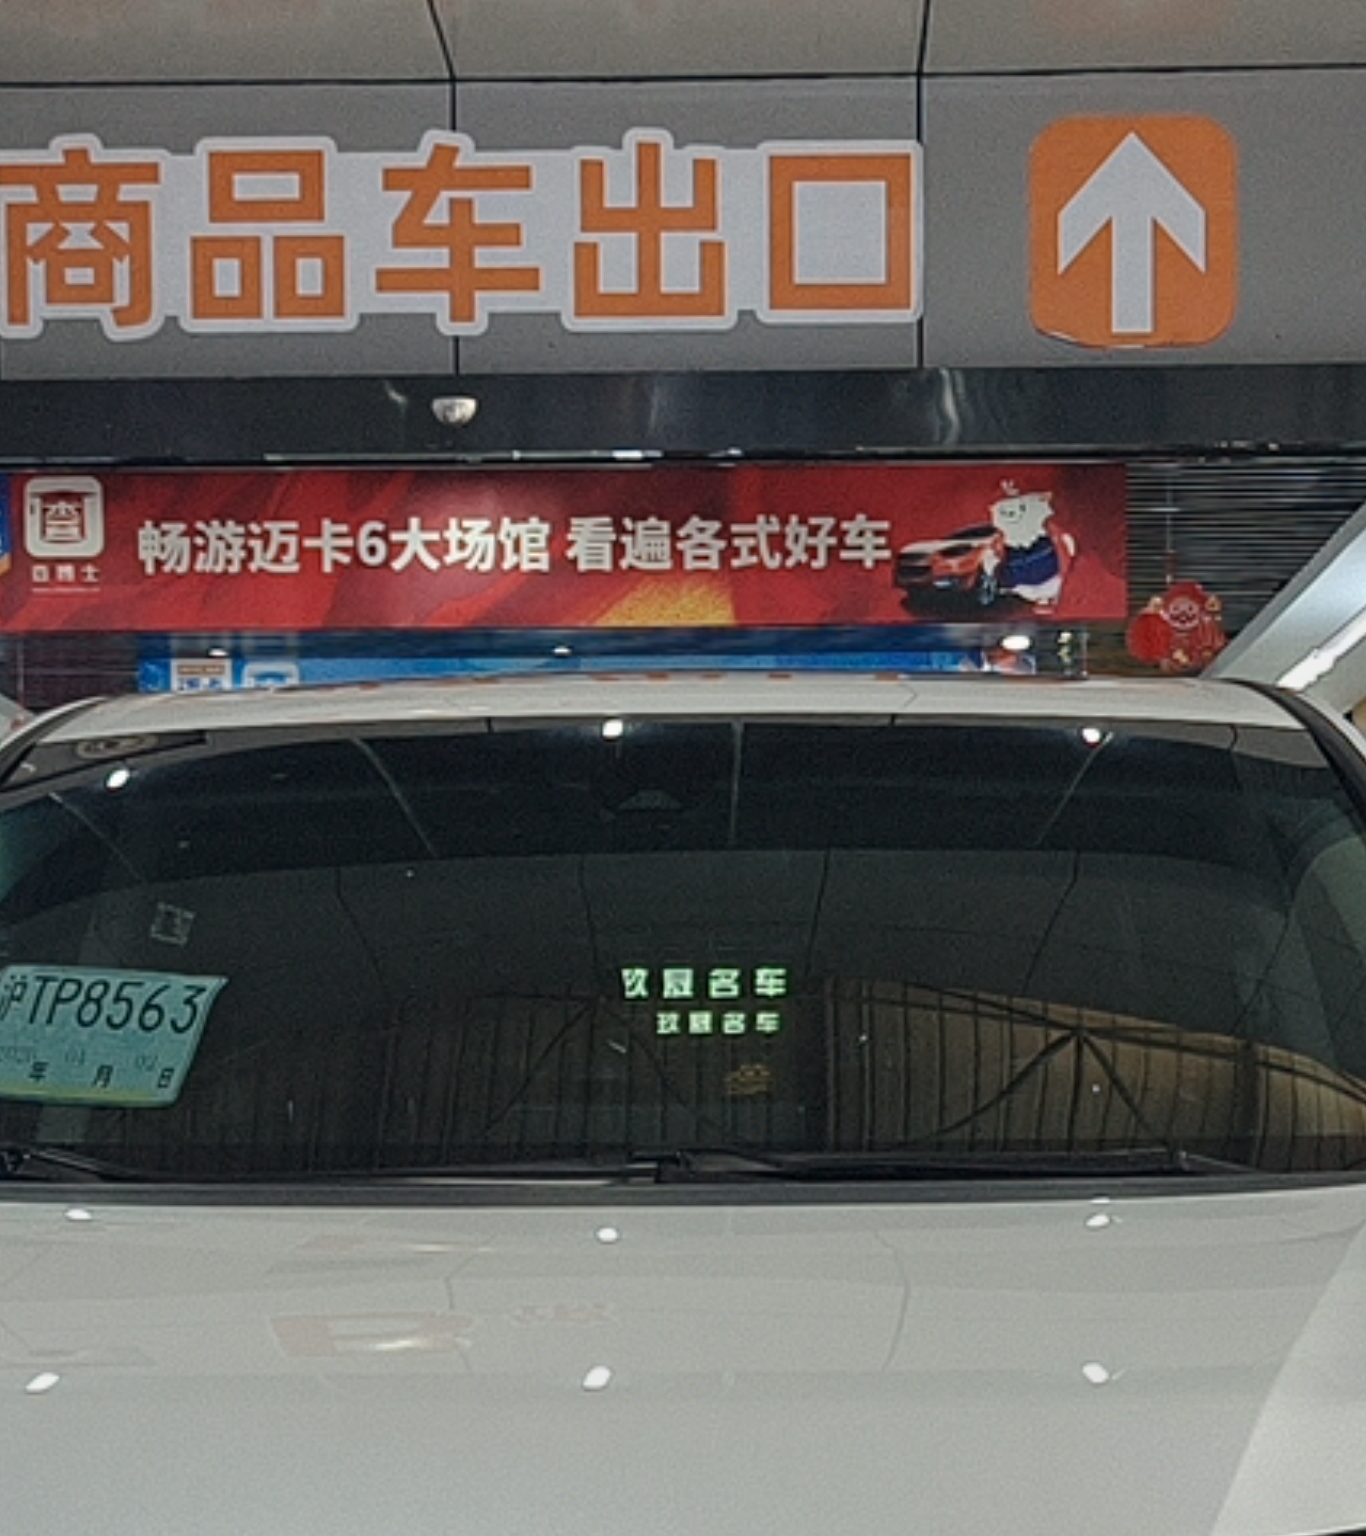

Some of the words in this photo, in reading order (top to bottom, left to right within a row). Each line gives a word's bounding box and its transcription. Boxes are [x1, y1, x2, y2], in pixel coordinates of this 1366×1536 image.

[138, 518, 551, 574] 畅游迈卡6大场馆
[566, 514, 892, 571] 看遍各式好车
